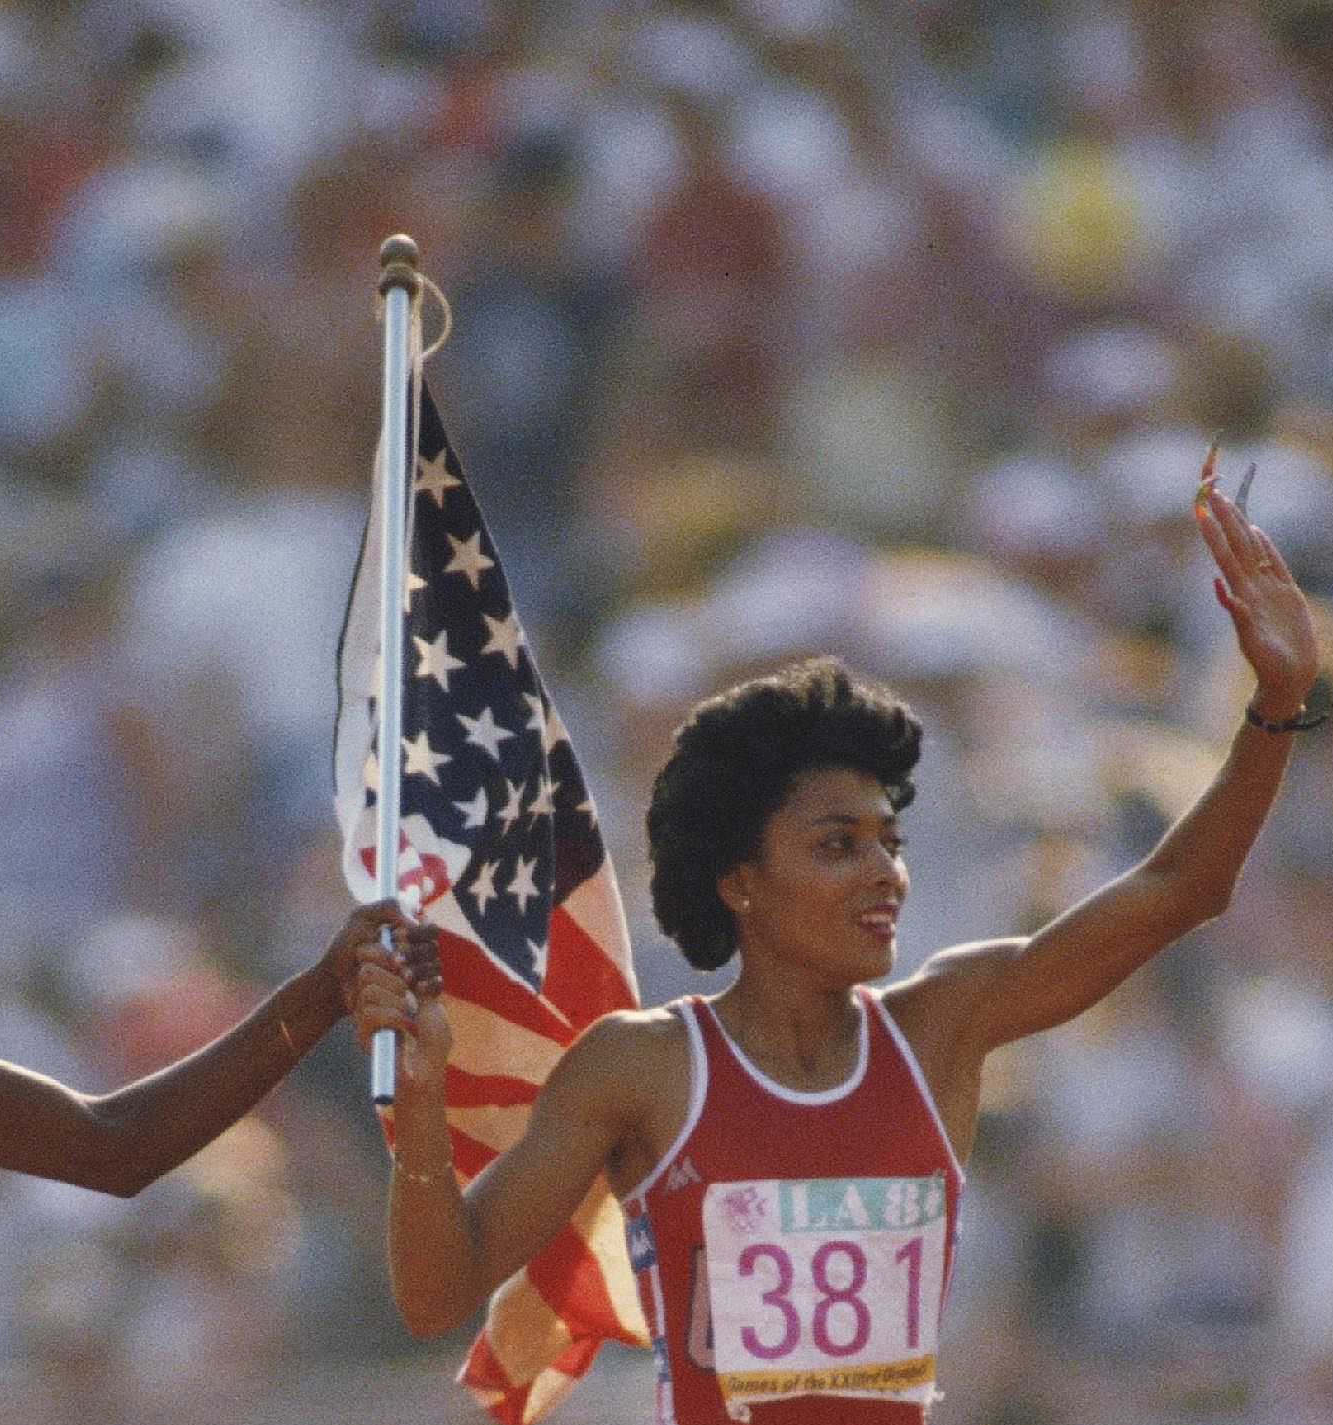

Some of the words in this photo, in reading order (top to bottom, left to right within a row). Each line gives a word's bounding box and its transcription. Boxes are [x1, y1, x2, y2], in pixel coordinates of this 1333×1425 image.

[738, 1236, 925, 1361] 381
[783, 1373, 801, 1393] of
[804, 1372, 827, 1390] the
